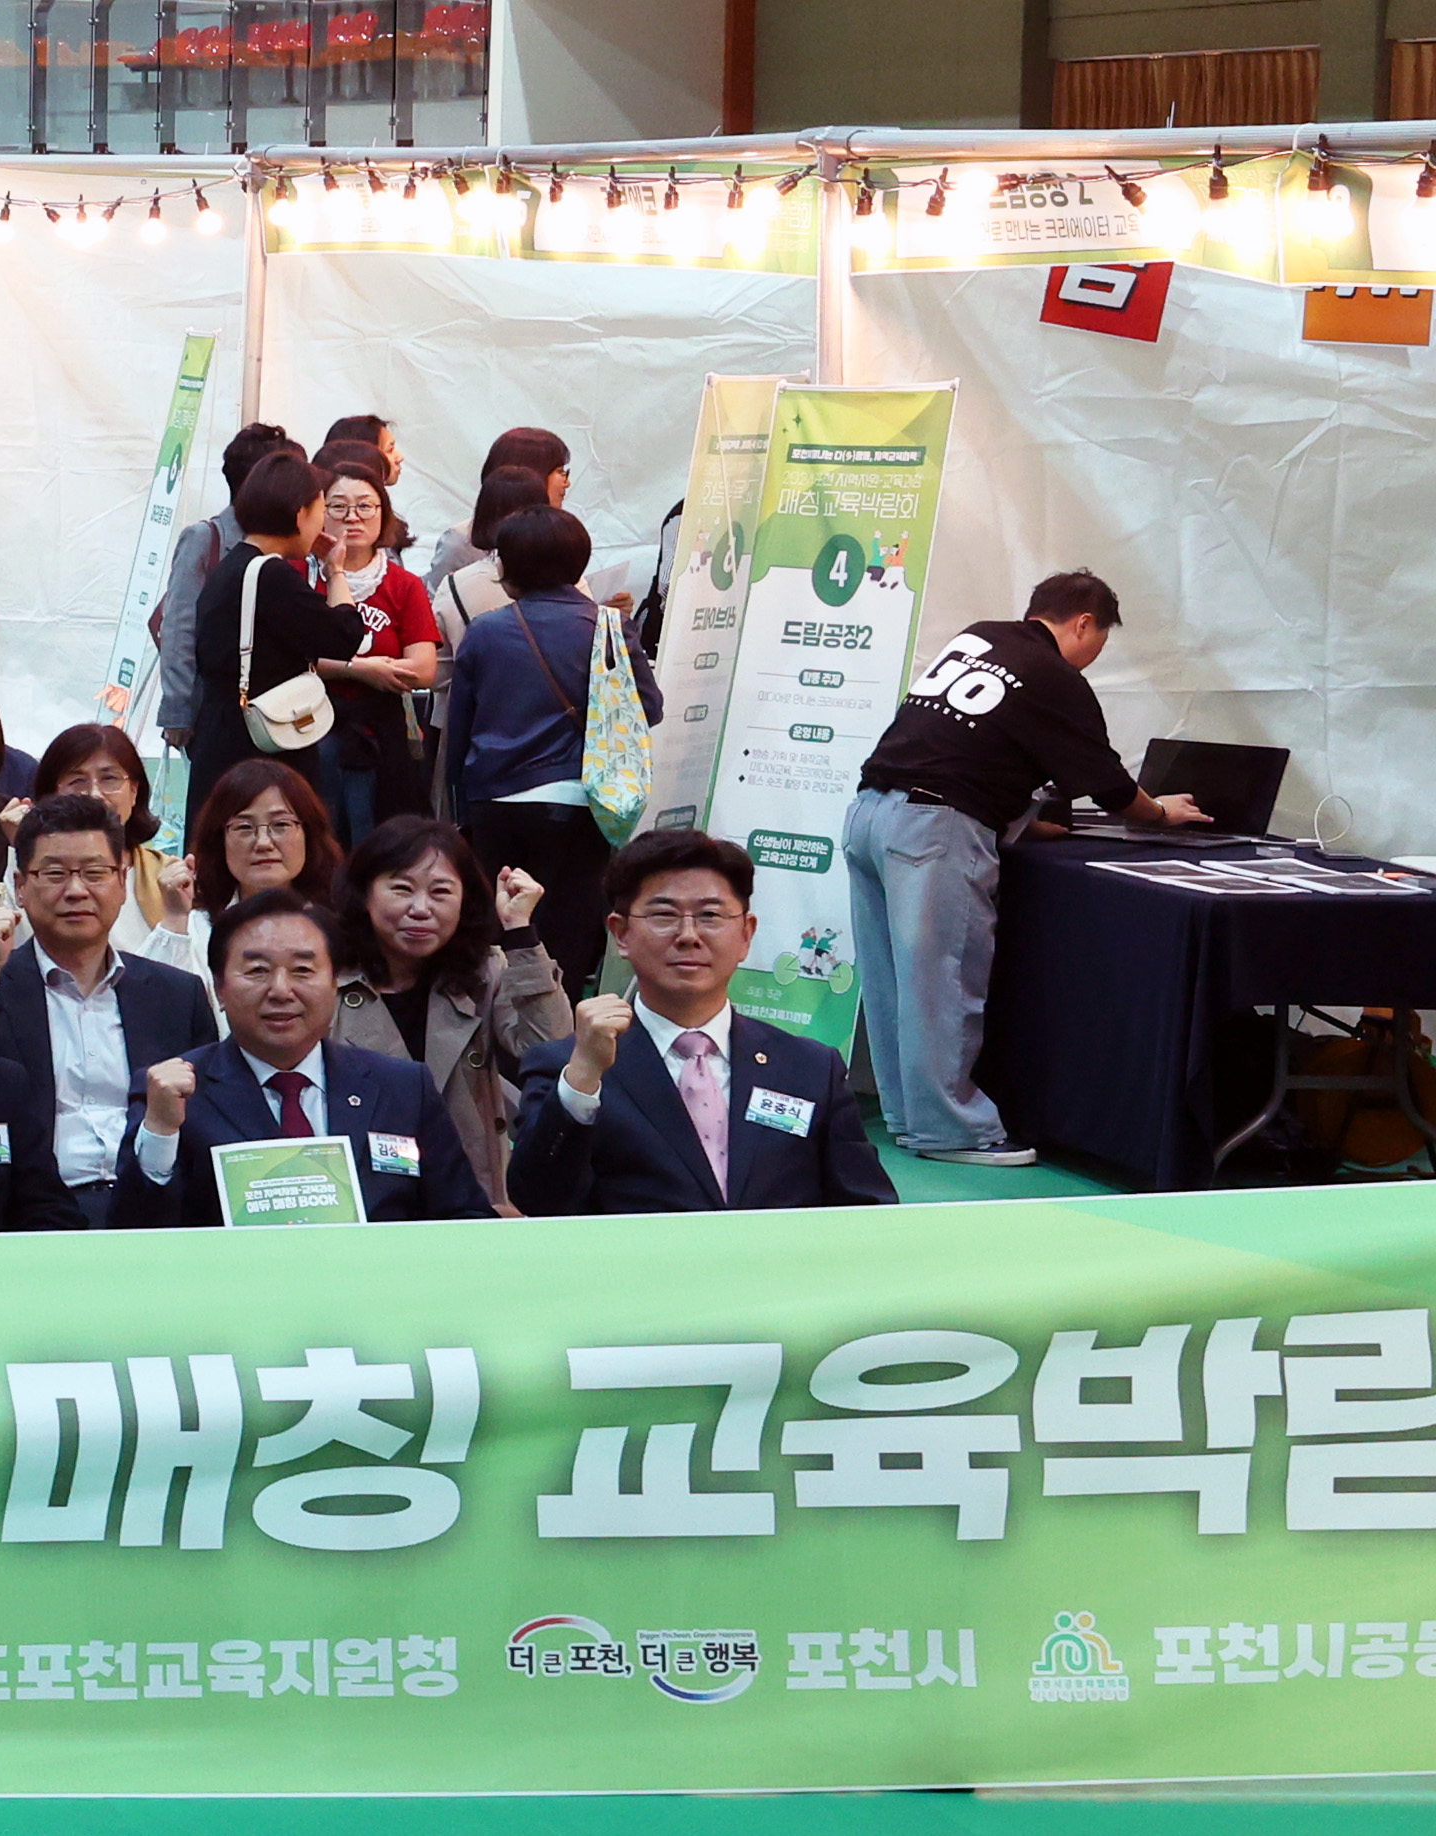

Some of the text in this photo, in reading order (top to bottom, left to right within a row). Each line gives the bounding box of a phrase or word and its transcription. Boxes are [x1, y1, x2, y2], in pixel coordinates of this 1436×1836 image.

[1006, 220, 1041, 242] 만나는
[1045, 213, 1110, 240] 크리에이터
[777, 488, 920, 519] 매칭 교육박람회
[829, 550, 848, 587] 4
[780, 620, 873, 650] 드림공장2
[793, 725, 831, 741] 운영 내용
[753, 834, 829, 856] 선생님이 제안하는
[759, 850, 819, 869] 교육과정 연계
[379, 1142, 414, 1158] 김성
[299, 1194, 339, 1208] BOOK
[0, 1344, 480, 1551] 매칭
[508, 1642, 759, 1676] 더 큰 포천, 더 큰 행복
[785, 1626, 979, 1692] 포천시
